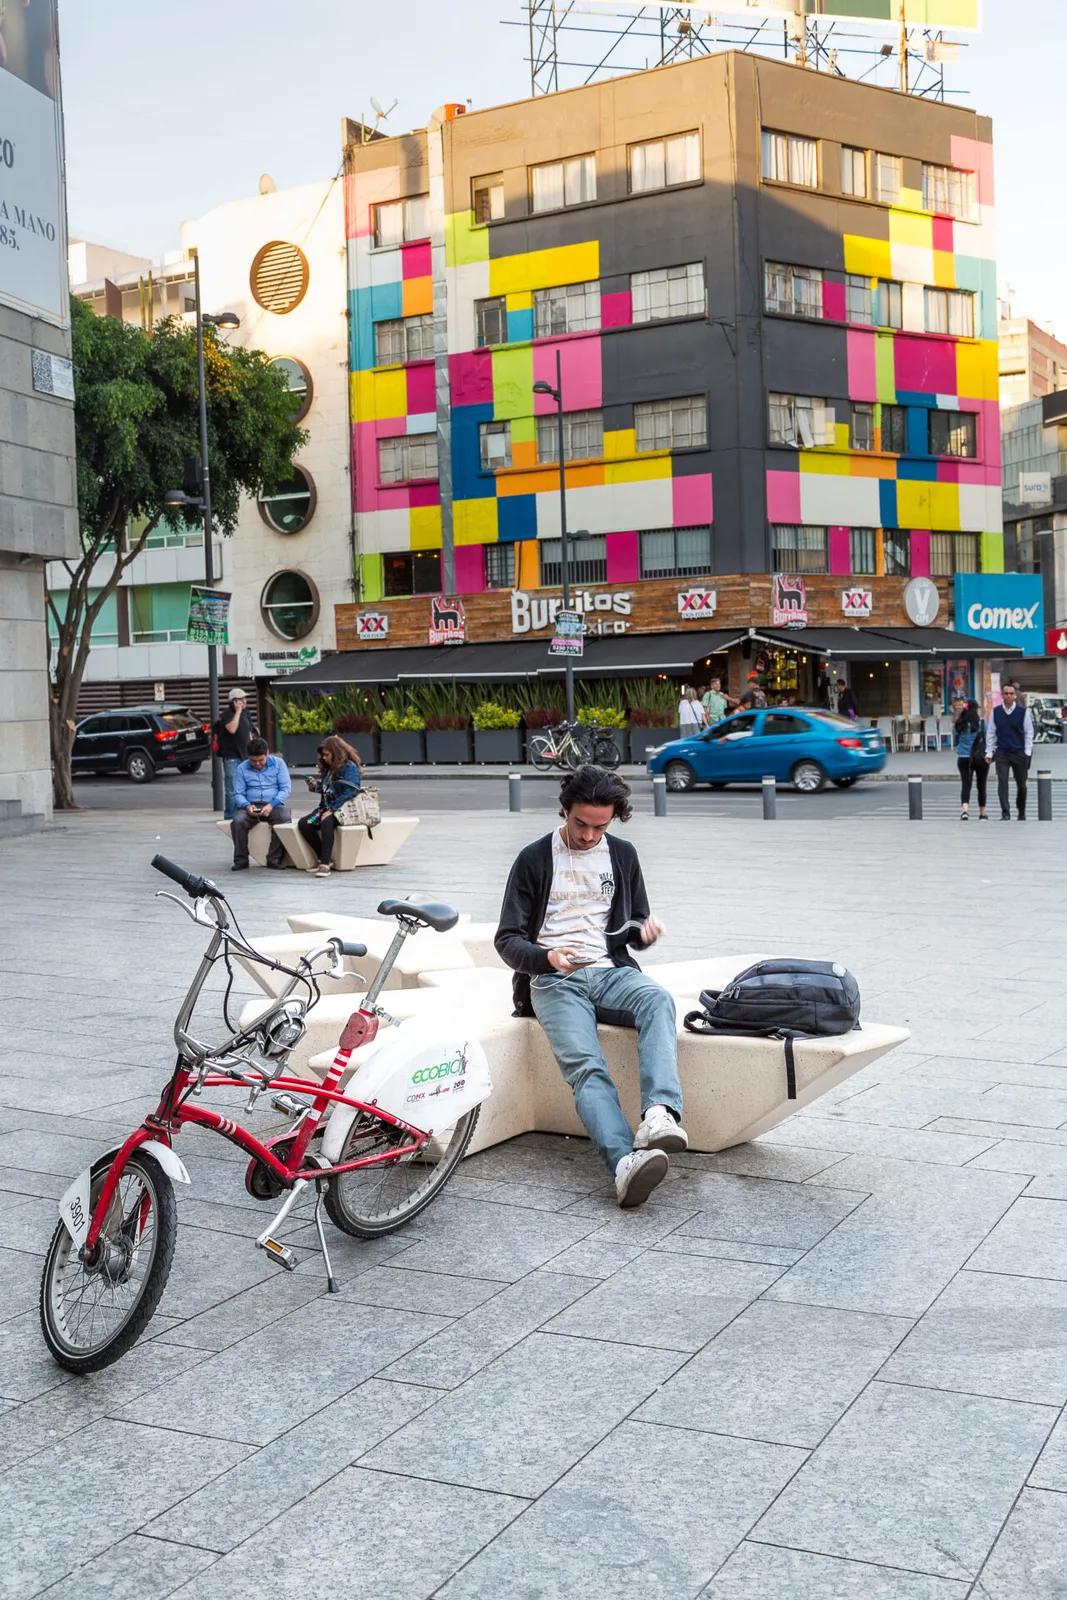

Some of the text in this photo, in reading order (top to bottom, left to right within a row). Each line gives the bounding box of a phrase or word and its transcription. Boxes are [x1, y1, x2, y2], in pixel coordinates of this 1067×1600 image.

[0, 138, 14, 168] O
[14, 204, 55, 242] MANO
[681, 592, 712, 611] XX
[844, 592, 869, 608] XX
[914, 588, 930, 614] V
[359, 617, 386, 632] XX
[581, 618, 626, 635] exico
[967, 602, 1040, 630] Comex
[412, 1058, 463, 1084] ECOBICI
[407, 1092, 426, 1103] CDMX
[70, 1196, 85, 1233] 3901
